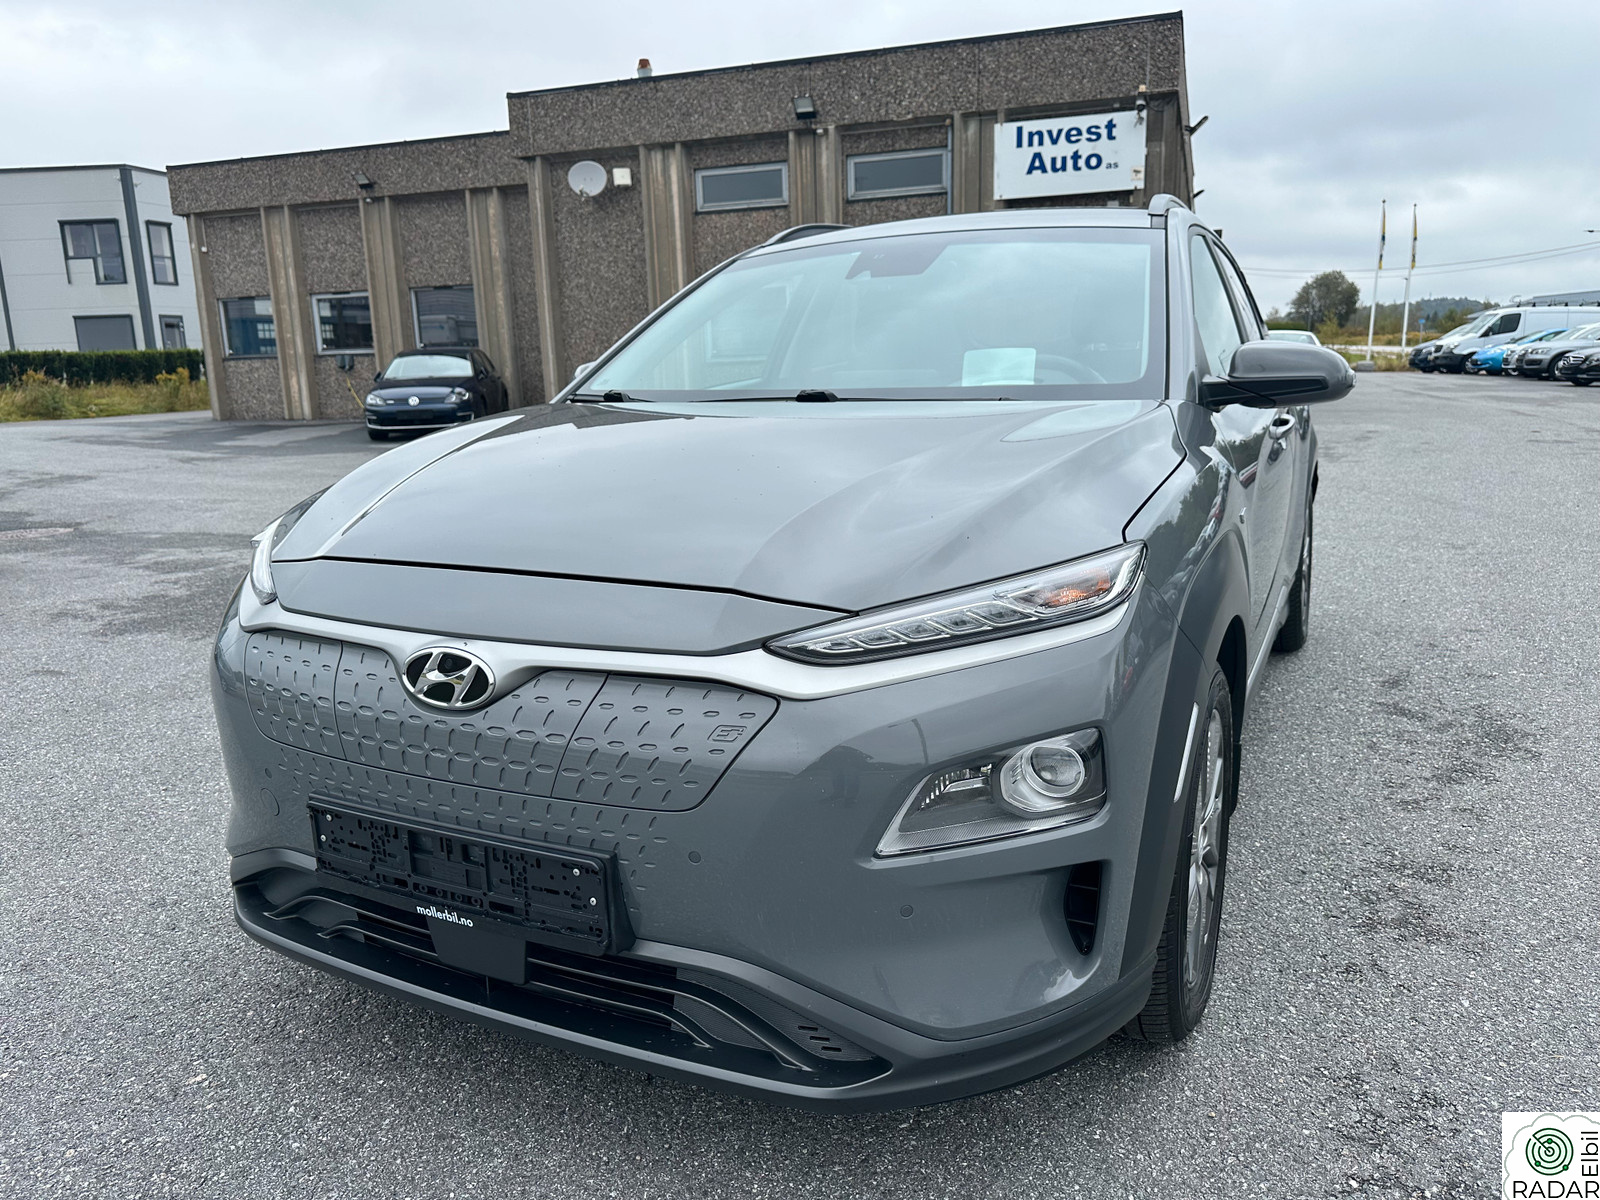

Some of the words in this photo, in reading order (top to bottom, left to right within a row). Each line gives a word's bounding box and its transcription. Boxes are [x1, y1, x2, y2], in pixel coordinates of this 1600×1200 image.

[1016, 118, 1117, 149] Invest
[1026, 149, 1103, 175] Auto
[1105, 161, 1119, 170] as
[416, 905, 474, 928] mollerbil.no
